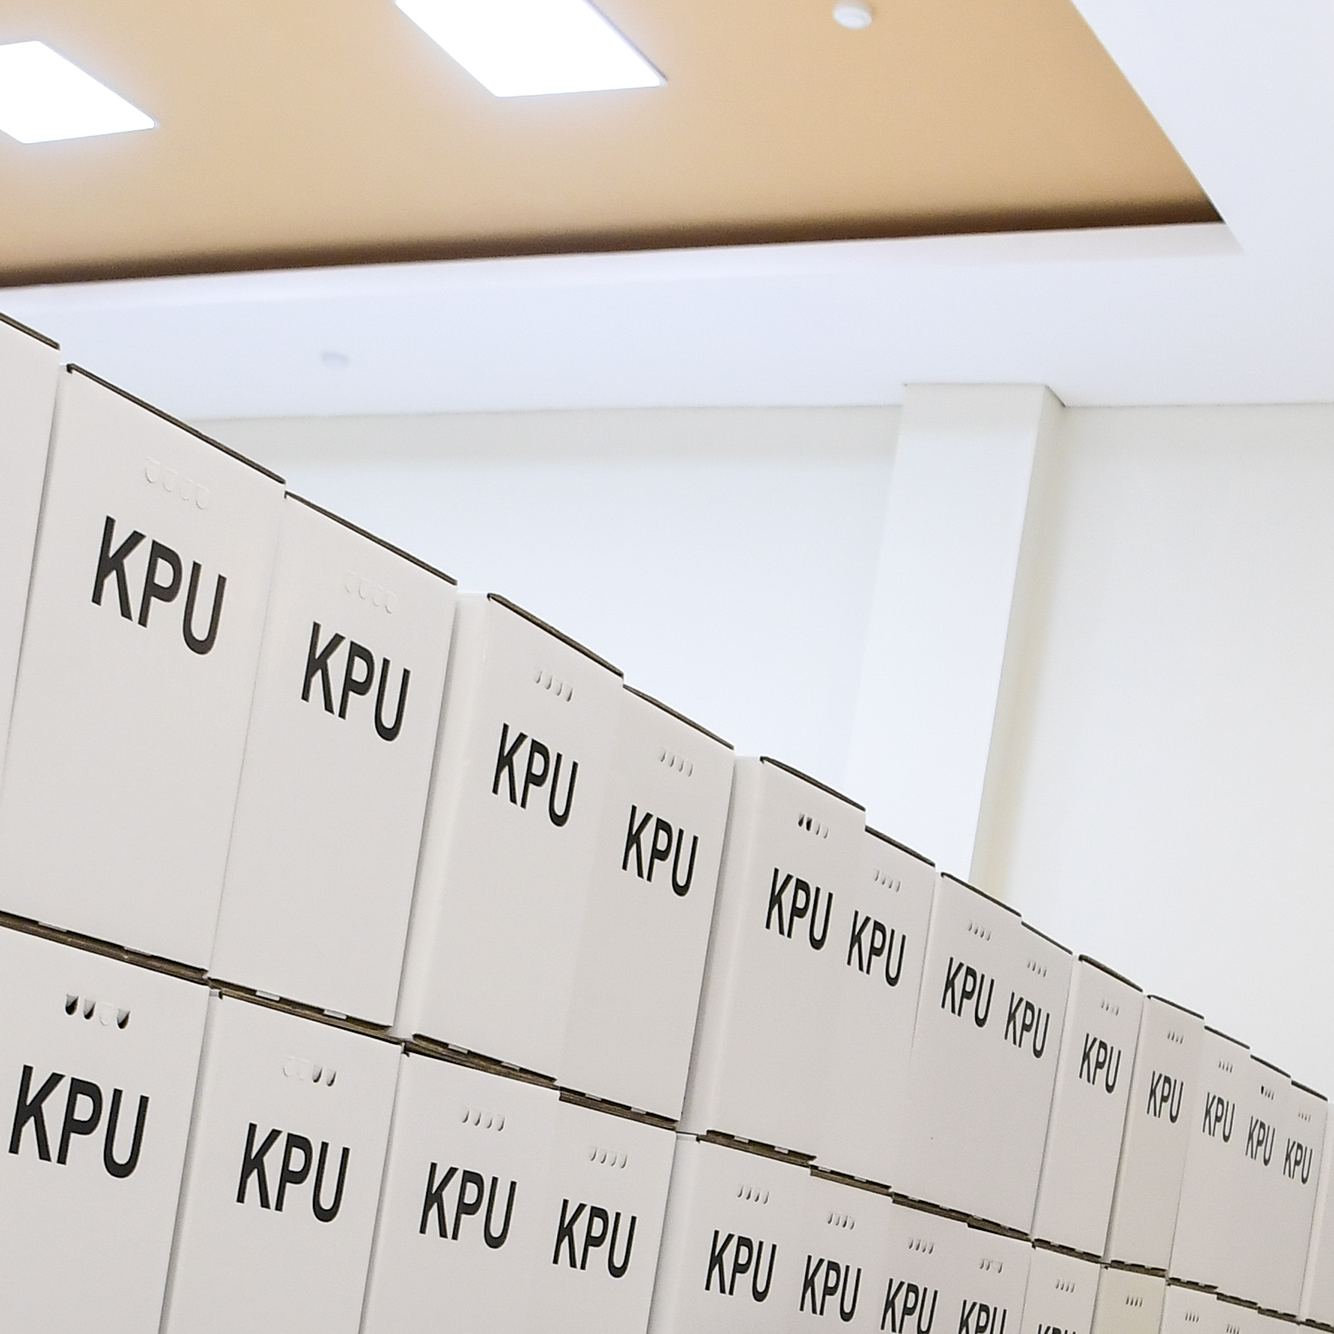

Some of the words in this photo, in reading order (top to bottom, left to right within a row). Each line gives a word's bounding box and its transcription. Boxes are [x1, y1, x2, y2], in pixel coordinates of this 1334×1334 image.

[91, 515, 227, 656] KPU
[300, 621, 411, 742] KPU
[491, 722, 579, 828] KPU
[621, 804, 699, 897] KPU
[765, 867, 834, 951] KPU
[846, 909, 907, 987] KPU
[940, 956, 995, 1028] KPU
[1004, 991, 1051, 1059] KPU
[1078, 1032, 1122, 1094] KPU
[1146, 1070, 1184, 1124] KPU
[8, 1064, 150, 1179] KPU
[1202, 1091, 1236, 1144] KPU
[1245, 1115, 1277, 1168] KPU
[235, 1122, 351, 1223] KPU
[1282, 1137, 1314, 1186] KPU
[418, 1161, 518, 1250] KPU
[552, 1198, 638, 1279] KPU
[704, 1229, 778, 1303] KPU
[799, 1254, 862, 1323] KPU
